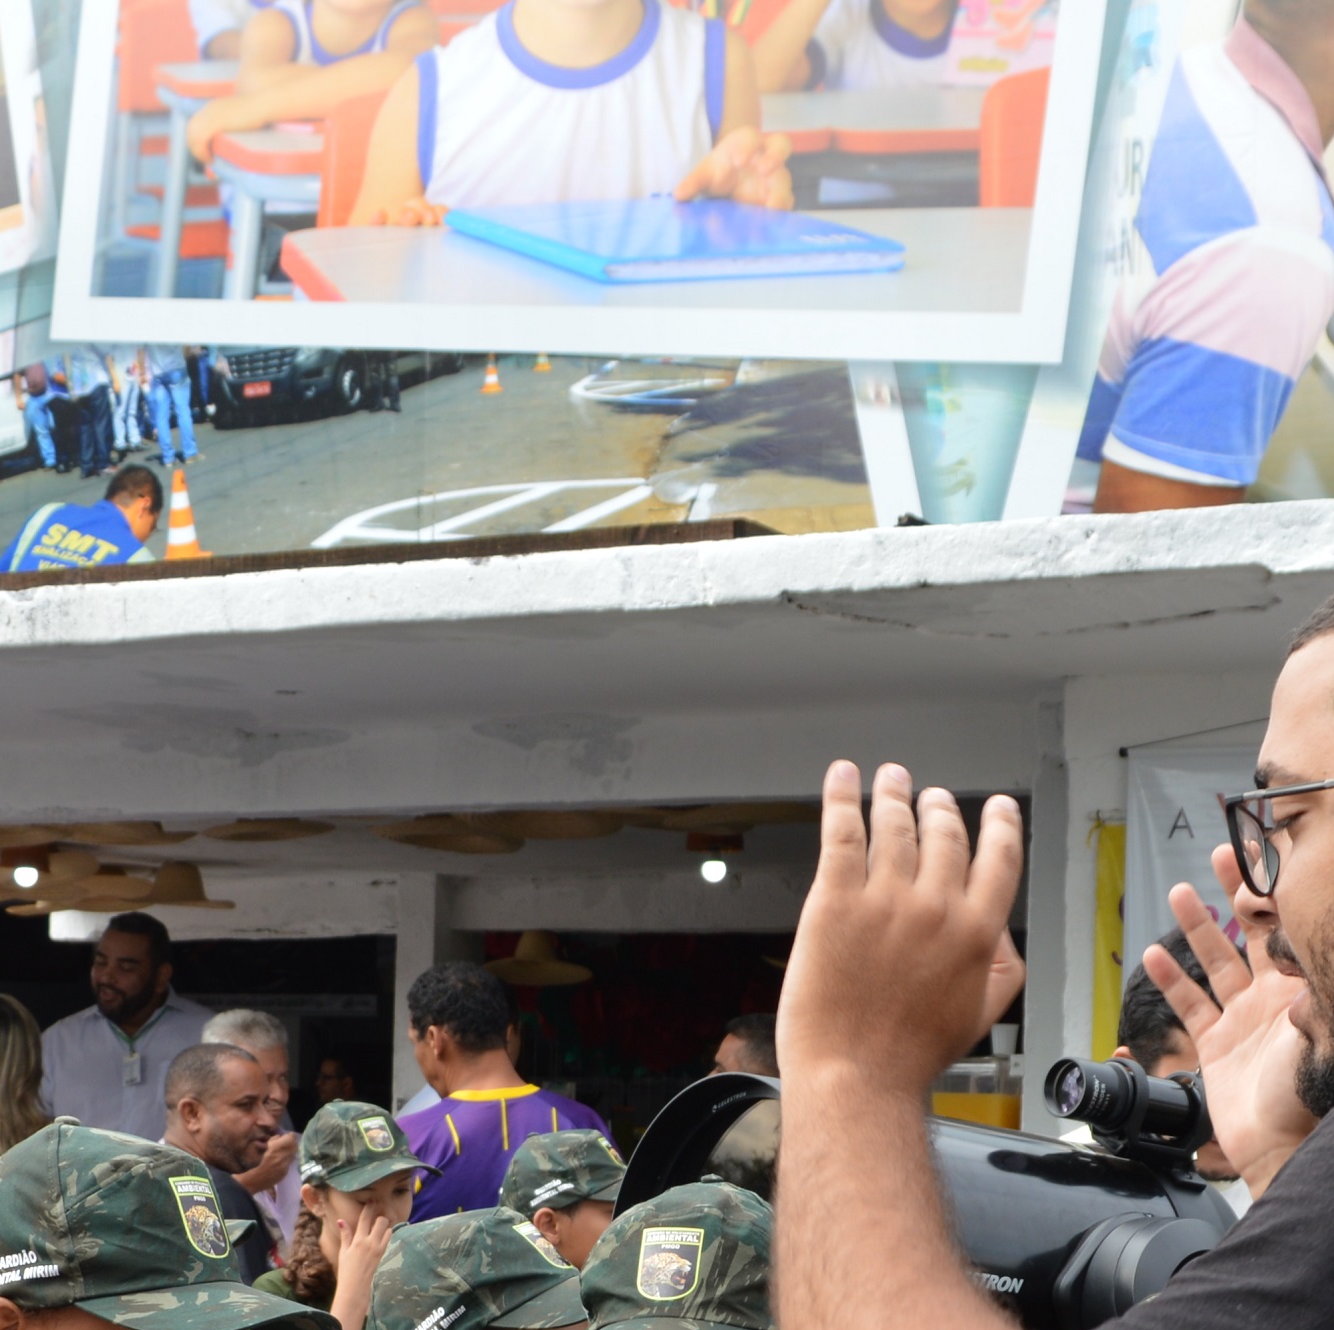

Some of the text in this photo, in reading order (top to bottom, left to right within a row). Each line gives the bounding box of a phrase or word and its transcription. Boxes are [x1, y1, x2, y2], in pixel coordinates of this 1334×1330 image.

[42, 523, 119, 562] SMT
[646, 1234, 699, 1243] AMBIENTAL
[23, 1264, 60, 1280] MIRIM
[439, 1304, 466, 1330] MIRIM
